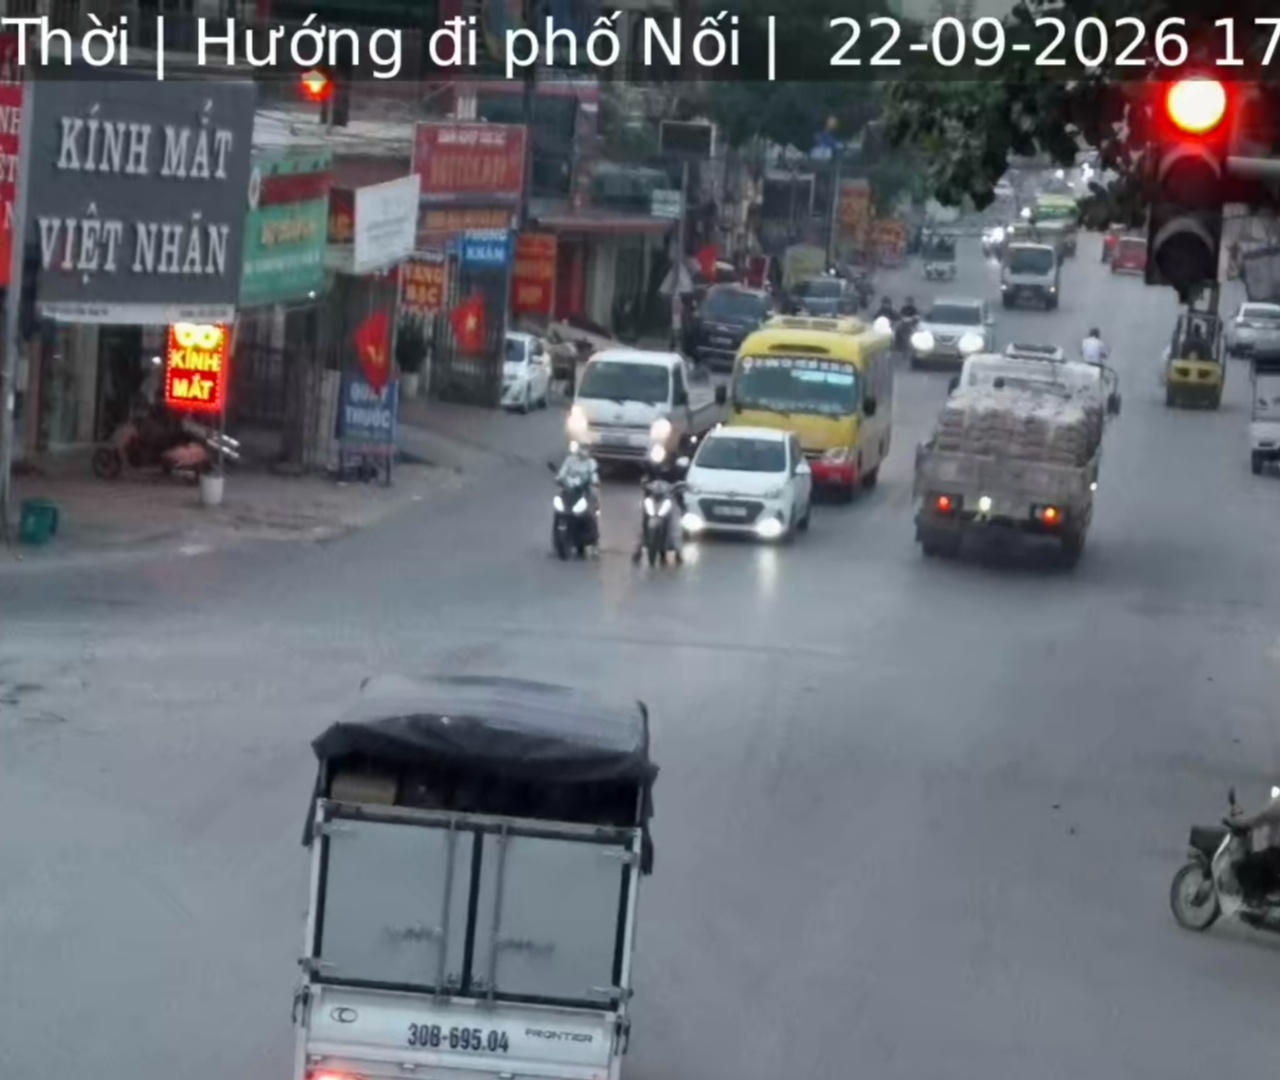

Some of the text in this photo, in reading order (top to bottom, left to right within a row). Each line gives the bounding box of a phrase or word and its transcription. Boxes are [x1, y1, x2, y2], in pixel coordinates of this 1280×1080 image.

[57, 98, 233, 179] KÍNH MẮT
[38, 202, 124, 285] VIỆT
[171, 347, 221, 372] KÍNH
[172, 374, 214, 401] MẮT
[407, 1021, 594, 1055] 30B-695.04 FRONTIER
